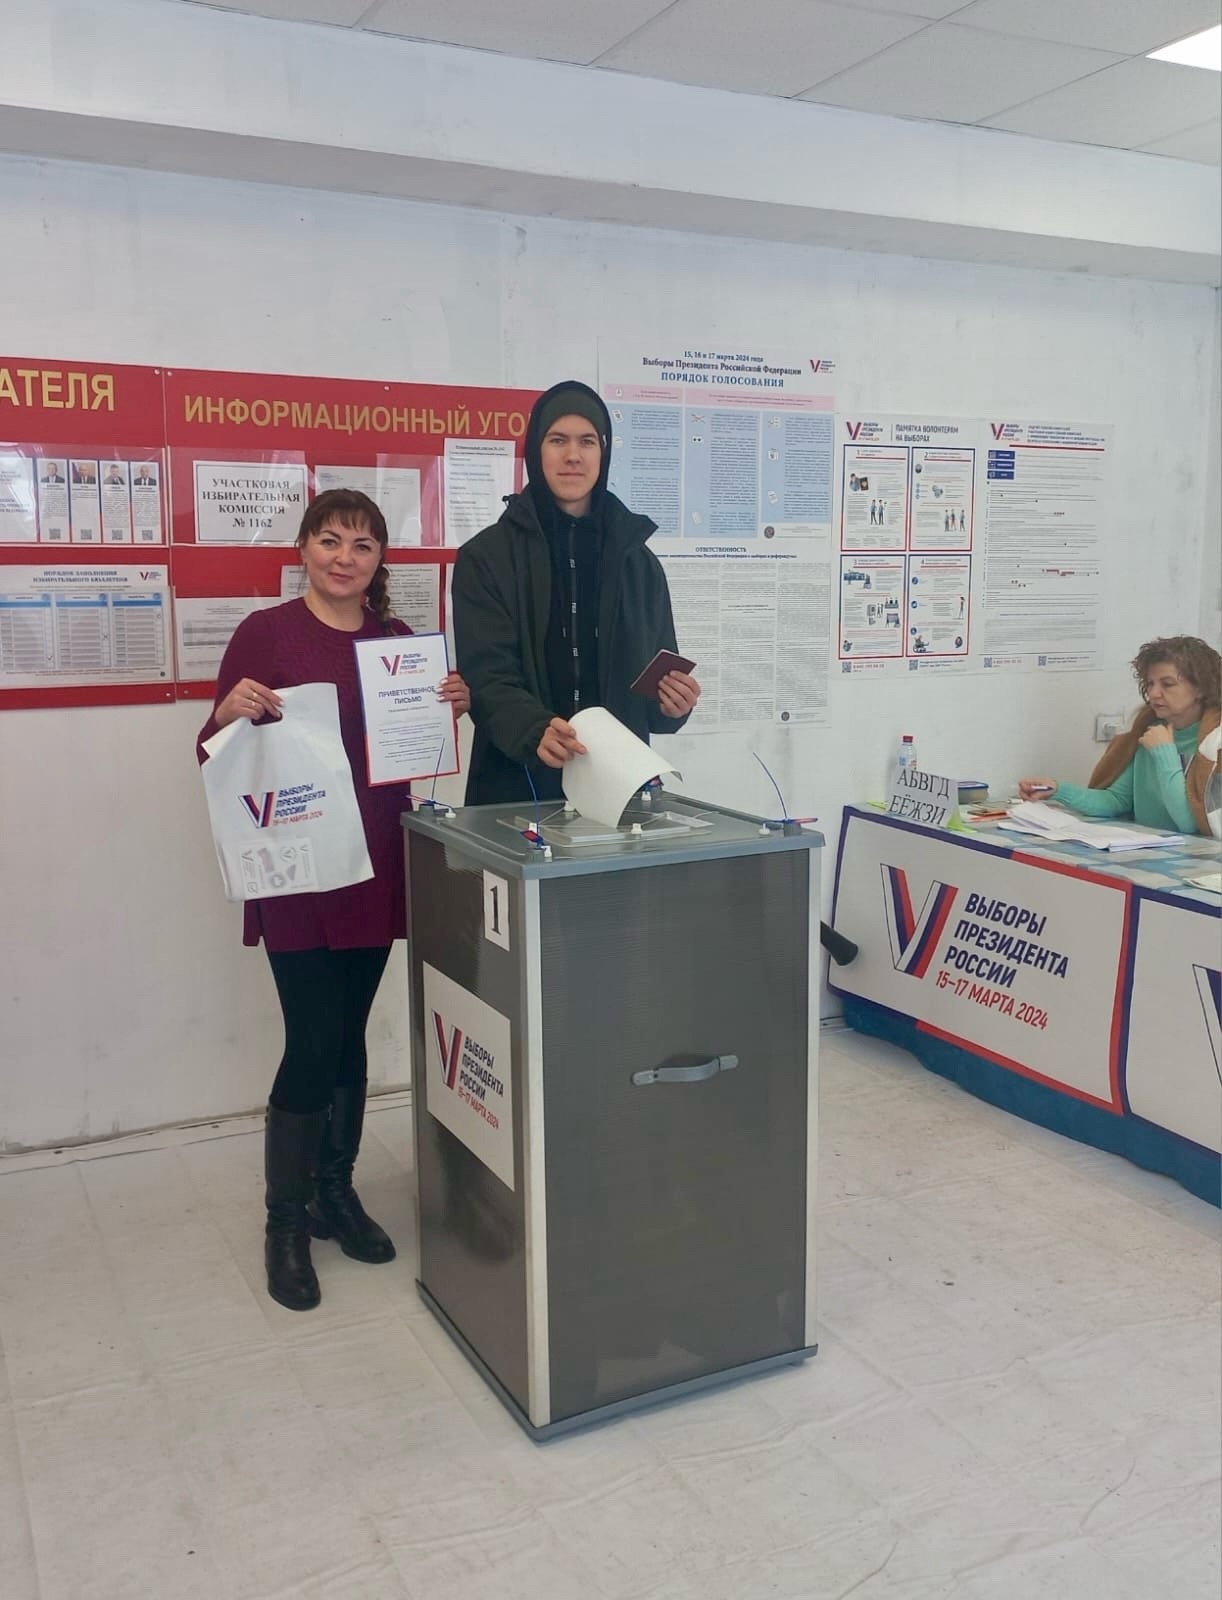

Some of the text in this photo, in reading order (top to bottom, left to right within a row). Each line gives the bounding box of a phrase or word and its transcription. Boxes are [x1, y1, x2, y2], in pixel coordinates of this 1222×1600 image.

[643, 357, 802, 376] Выборы Президента Российской Федерации
[661, 372, 784, 387] ПОРЯДОК ГОЛОСОВАНИЯ
[184, 394, 470, 435] ИНФОРМАЦИОННЫЙ
[896, 424, 959, 434] ПАМЯТКА ВОЛОНТЕРАМ
[212, 478, 290, 489] УЧАСТКОВАЯ
[202, 491, 300, 502] ИЗБИРАТЕЛЬНАЯ
[219, 504, 285, 514] КОМИССИЯ
[232, 518, 273, 528] № 1162
[378, 686, 436, 698] ПРИВЕТСТВЕННОЕ
[394, 696, 422, 704] ПИСЬМО
[278, 783, 314, 797] ВЫБОРЫ
[896, 768, 950, 801] АБВГД
[274, 805, 306, 818] РОССИИ
[276, 790, 326, 808] ПРЕЗИДЕНТА
[889, 793, 947, 825] ЕЁЖЗИ
[490, 885, 502, 936] 1
[964, 892, 1047, 936] ВЫБОРЫ
[954, 919, 1069, 979] ПРЕЗИДЕНТА
[944, 945, 1018, 988] РОССИИ
[967, 983, 1015, 1016] МАРТА
[1015, 1002, 1049, 1030] 2024
[464, 1036, 495, 1070] ВЫБОРЫ
[460, 1070, 486, 1101] РОССИИ
[462, 1053, 504, 1098] ПРЕЗИДЕНТА
[470, 1097, 487, 1118] МАРТА
[486, 1111, 500, 1130] 2024
